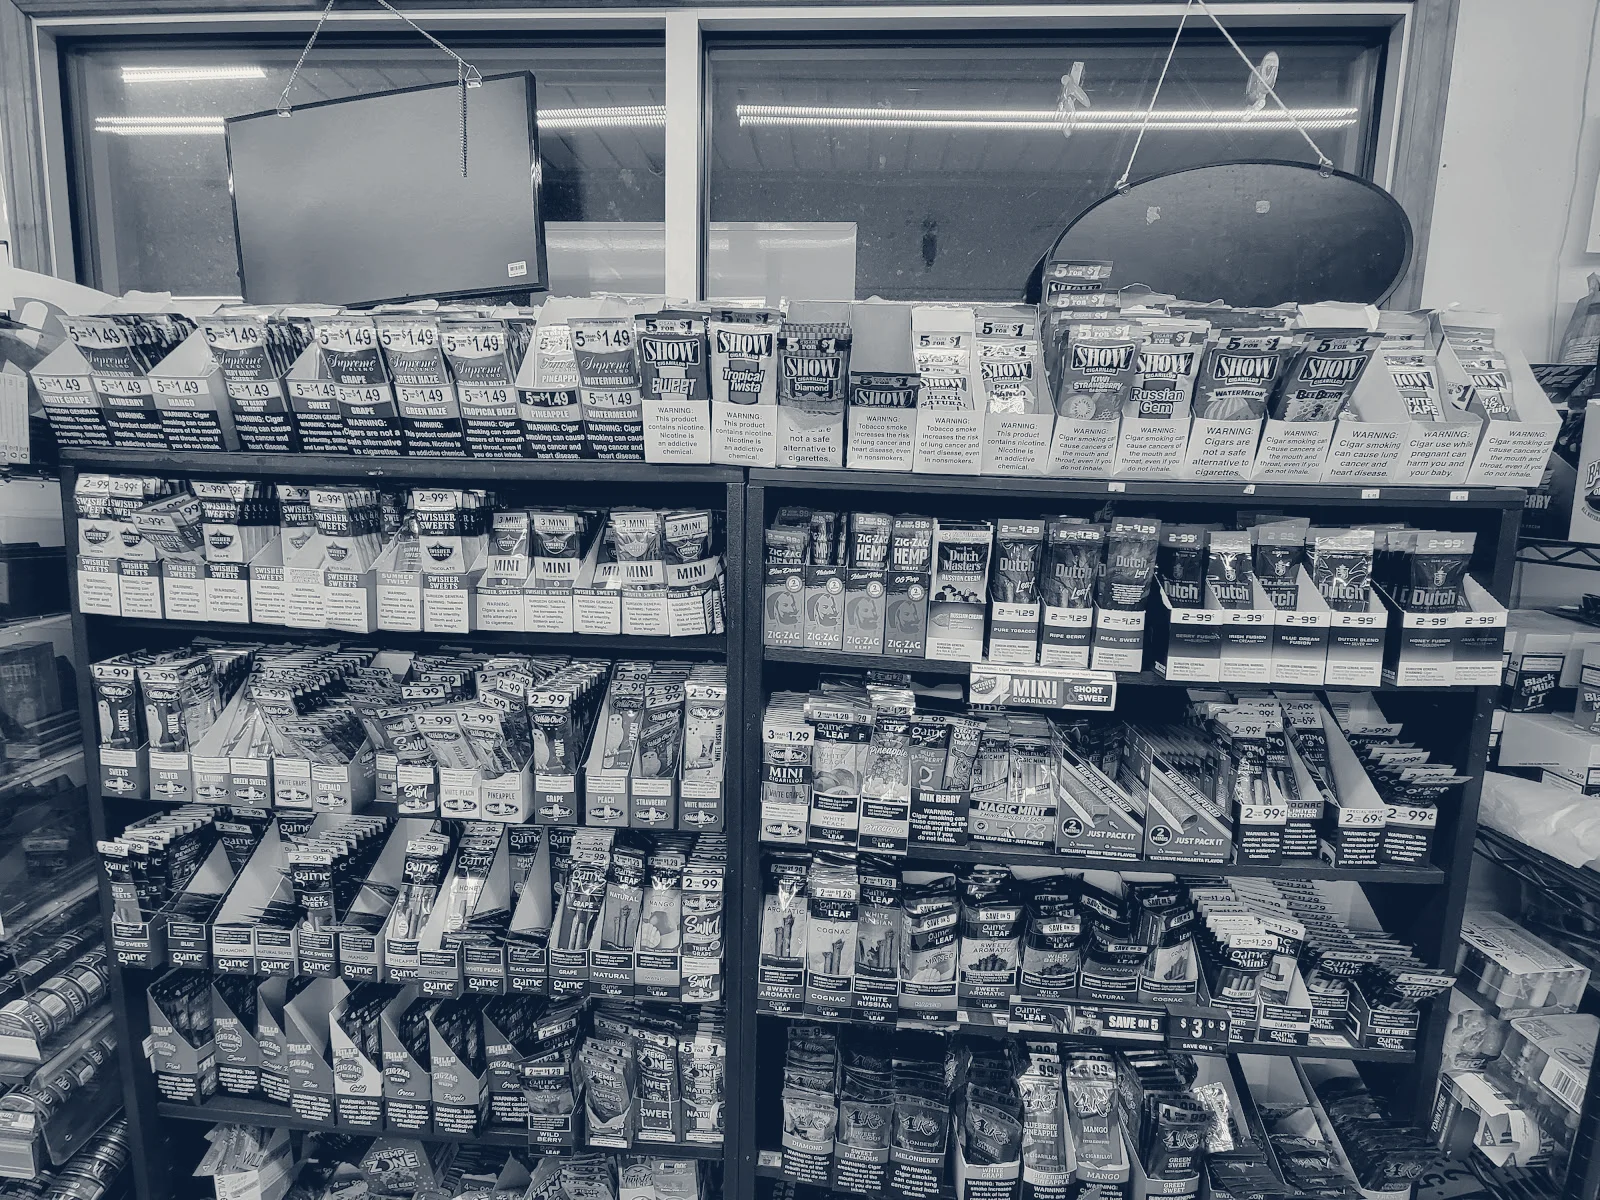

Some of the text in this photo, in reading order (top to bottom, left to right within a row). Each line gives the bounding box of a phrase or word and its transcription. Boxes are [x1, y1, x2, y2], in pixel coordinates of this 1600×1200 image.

[646, 319, 657, 331] 5
[87, 327, 121, 343] $1.49
[320, 329, 372, 346] 5 $1.49
[575, 330, 631, 347] 5 $1.49
[718, 332, 770, 354] SHOW
[1226, 338, 1242, 350] 5
[643, 340, 698, 363] SHOW
[1073, 348, 1134, 370] SHOW
[784, 358, 837, 378] SHOW
[1217, 356, 1279, 378] SHOW
[340, 375, 366, 384] GRAPE
[583, 376, 634, 385] WATERMELON
[723, 368, 765, 383] Tropical
[52, 379, 81, 391] $1.49
[730, 380, 761, 393] Twista
[794, 384, 829, 392] Diamond
[43, 395, 91, 404] WHITE GRAPE
[415, 389, 443, 402] $1.49
[1131, 389, 1184, 402] Russian
[168, 398, 195, 407] MANGO
[307, 401, 330, 410] SWEET
[1141, 402, 1172, 414] Gem
[405, 407, 447, 415] GREEN HAZE
[463, 407, 516, 416] TROPICAL BUZZ
[531, 410, 569, 418] PINEAPPLE
[588, 410, 638, 418] WATERMELON
[346, 418, 387, 428] WARNING:
[1206, 427, 1254, 435] WARNING:
[1352, 431, 1399, 439] WARNING:
[1204, 438, 1234, 447] Cigars
[1339, 440, 1401, 450] Cigar smoking
[1411, 451, 1449, 460] pregnant
[1195, 468, 1241, 477] cigarettes.
[1433, 469, 1453, 477] baby.
[416, 512, 456, 522] SWISHER
[419, 521, 455, 530] SWEETS
[856, 544, 886, 561] HEMP
[949, 549, 979, 562] Dutch
[943, 560, 982, 571] Masters
[1000, 558, 1035, 572] Dutch
[676, 564, 706, 580] MINI
[1412, 589, 1457, 606] Dutch
[888, 640, 921, 649] ZIG-ZAG
[1524, 673, 1555, 687] Black
[1013, 679, 1058, 698] MINI
[1073, 686, 1103, 694] SHORT
[1531, 681, 1555, 694] Mild
[1078, 694, 1108, 703] SWEET
[1528, 693, 1546, 706] FT
[786, 731, 810, 742] $1.29
[769, 767, 803, 778] MINI
[318, 783, 341, 792] EMERALD
[403, 785, 428, 799] Swirl
[1075, 764, 1132, 813] TERPENE INFUSED
[920, 793, 961, 804] MIX BERRY
[1087, 831, 1105, 839] JUST
[1106, 831, 1126, 840] PACK
[609, 892, 639, 902] NATURAL
[684, 916, 720, 935] Swirl
[117, 952, 147, 965] game
[469, 979, 499, 992] game
[1109, 1016, 1159, 1030] SAVE ON 5
[640, 1108, 672, 1119] SWEET
[1431, 1093, 1447, 1133] TOXIN FREE
[792, 1140, 823, 1151] DIAMOND
[366, 1153, 419, 1173] ZONE
[845, 1154, 878, 1162] DELICIOUS
[895, 1152, 940, 1164] MELONBERRY
[1087, 1172, 1120, 1180] MANGO
